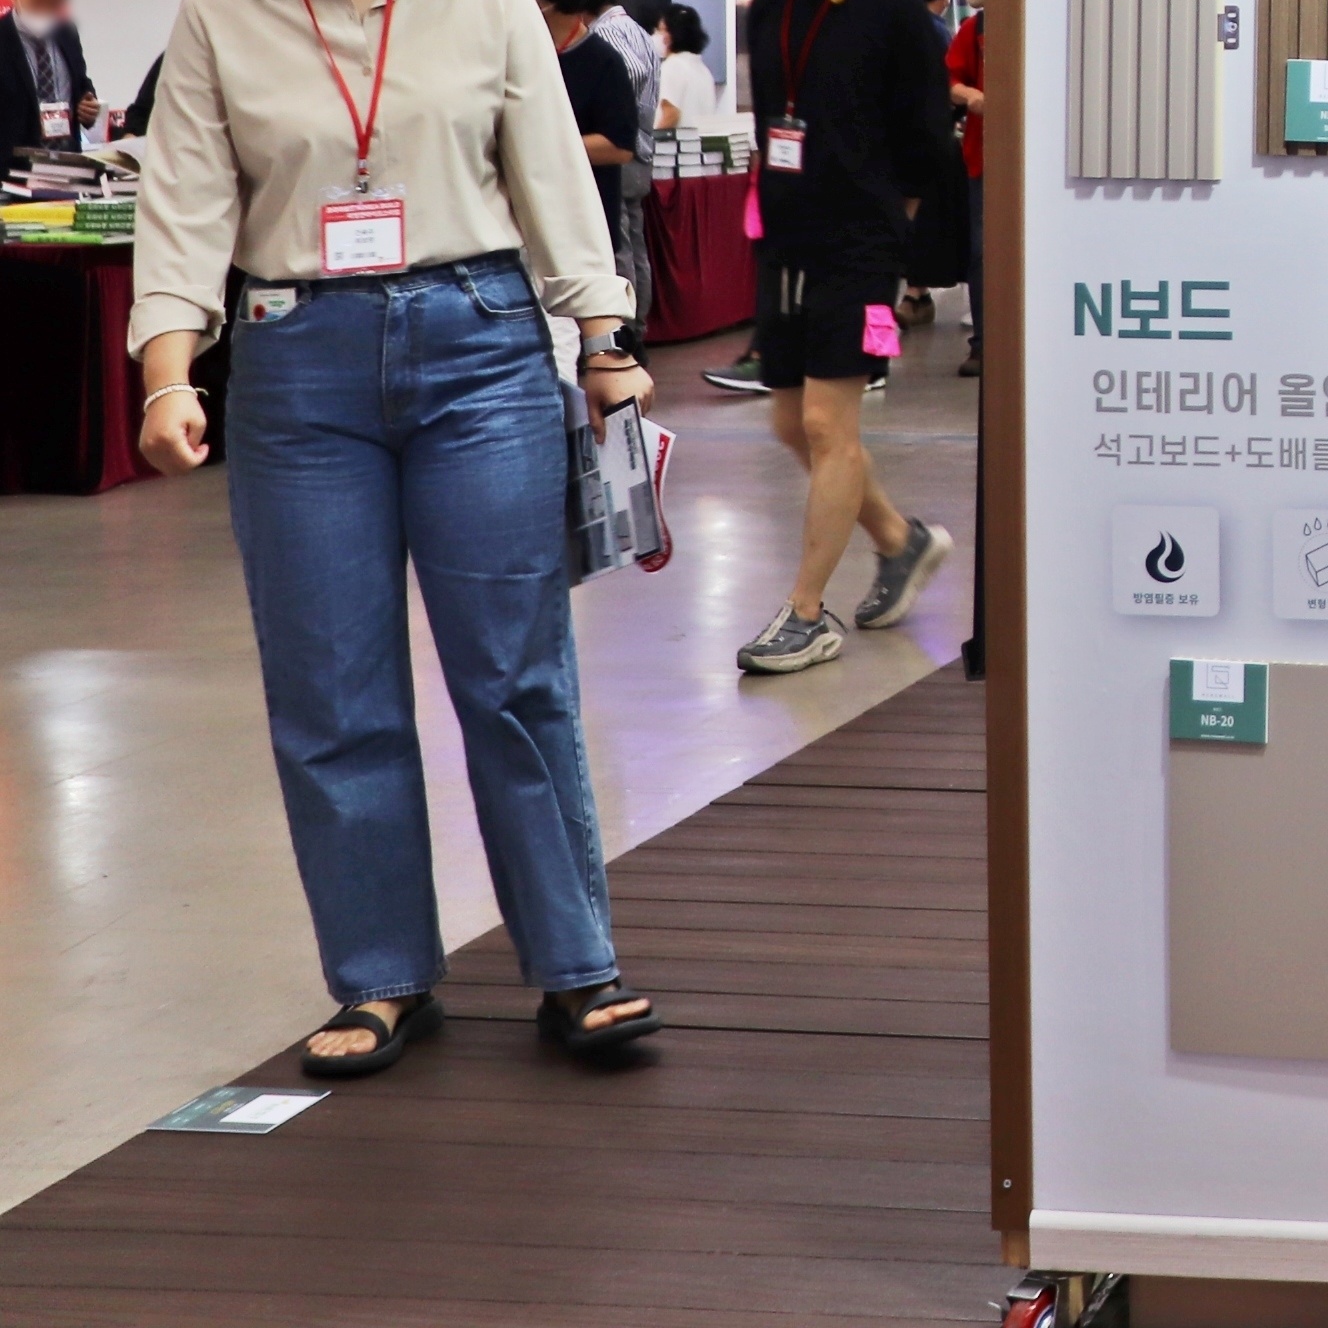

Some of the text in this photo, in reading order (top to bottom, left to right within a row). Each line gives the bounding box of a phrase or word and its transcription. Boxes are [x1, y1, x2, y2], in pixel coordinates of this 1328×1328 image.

[1073, 278, 1234, 341] N보드
[1092, 369, 1258, 416] 인테리어
[1132, 592, 1200, 606] 방염필증 보유
[1307, 598, 1328, 610] 변형
[1201, 714, 1235, 727] NB-20
